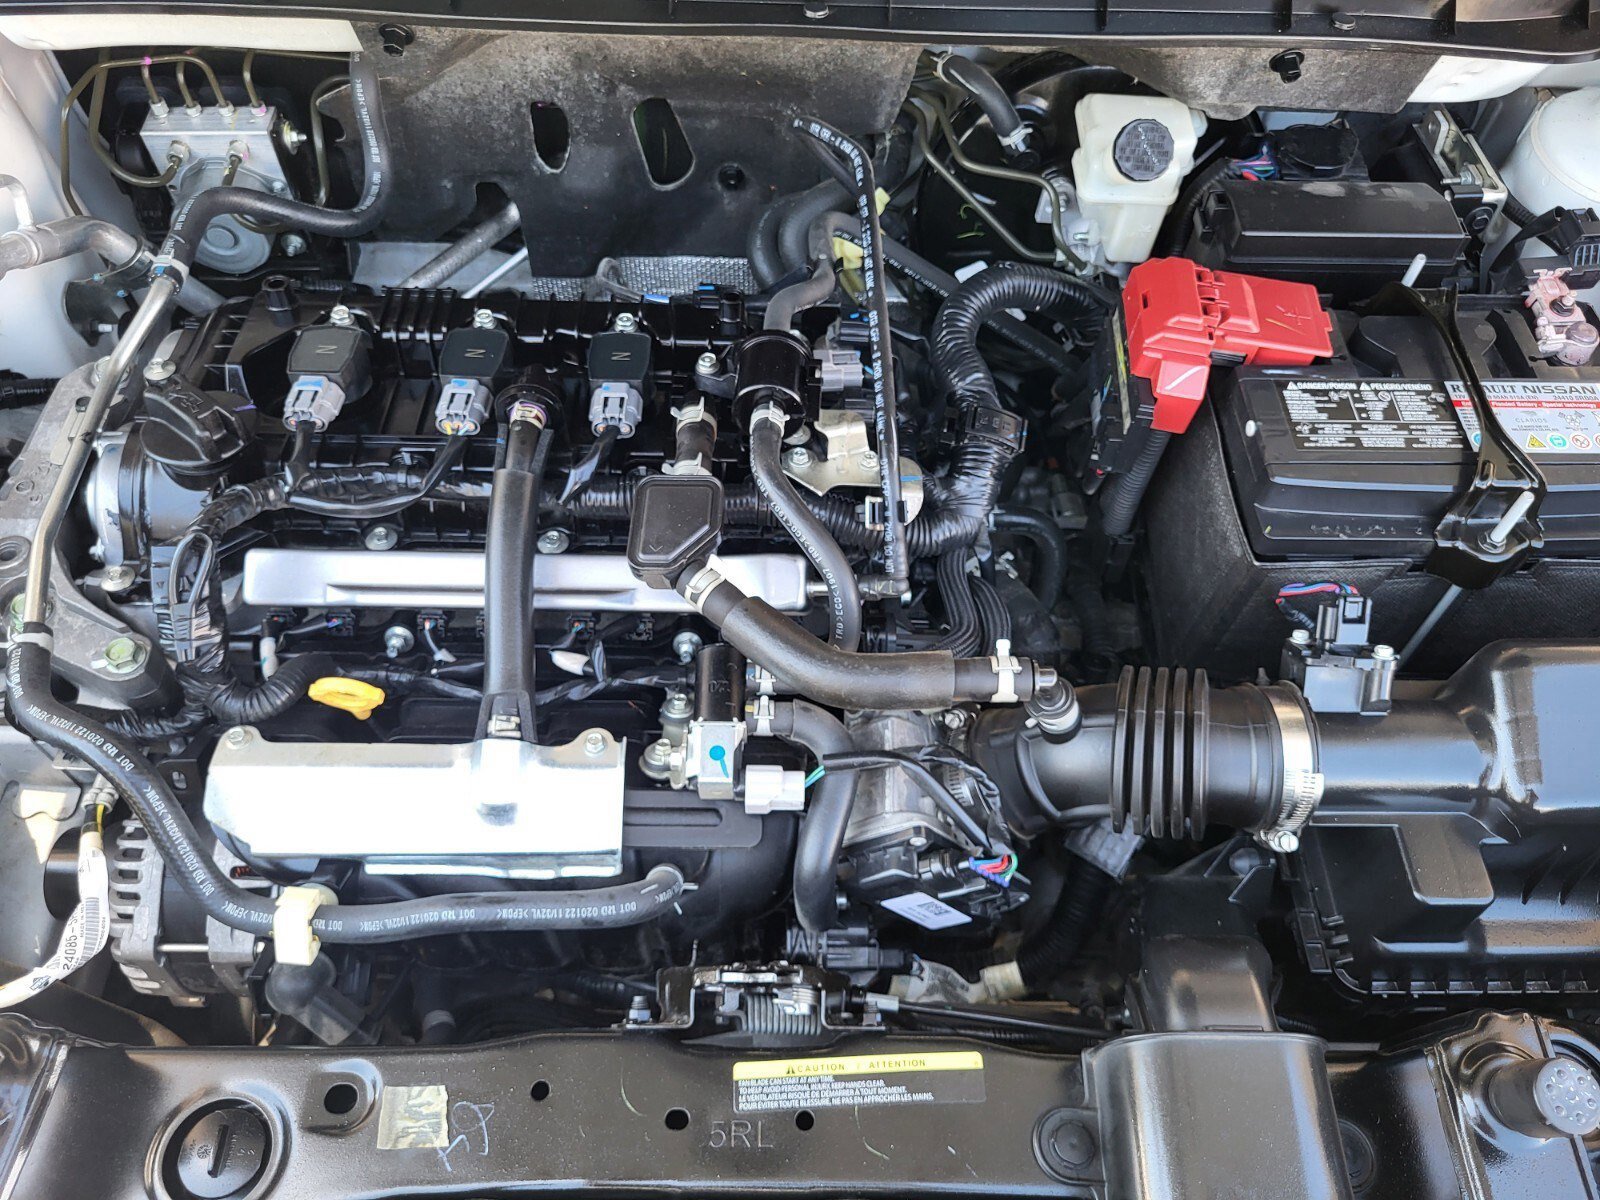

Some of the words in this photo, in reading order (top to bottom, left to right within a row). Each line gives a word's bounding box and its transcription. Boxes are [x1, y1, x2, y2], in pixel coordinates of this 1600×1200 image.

[1450, 384, 1516, 394] RAULT
[1522, 385, 1597, 395] NISSAN
[75, 725, 104, 744] 020122
[117, 753, 135, 772] DOT
[143, 785, 168, 817] >EPDM<
[176, 841, 199, 870] 020122
[221, 900, 248, 919] >EPDM<
[459, 908, 475, 919] DOT
[565, 907, 598, 919] 020122
[620, 902, 636, 913] DOT
[410, 911, 439, 923] 020122
[327, 920, 343, 931] DOT
[798, 1064, 845, 1073] CAUTION
[869, 1059, 926, 1069] ATTENTION
[781, 1084, 810, 1092] PERSONAL
[739, 1102, 757, 1110] POUR
[780, 1100, 799, 1108] TOUTE
[864, 1095, 900, 1104] APPROCHER
[901, 1094, 912, 1102] LES
[747, 1093, 787, 1101] VENTILATEUR
[710, 1121, 773, 1148] 5RL
